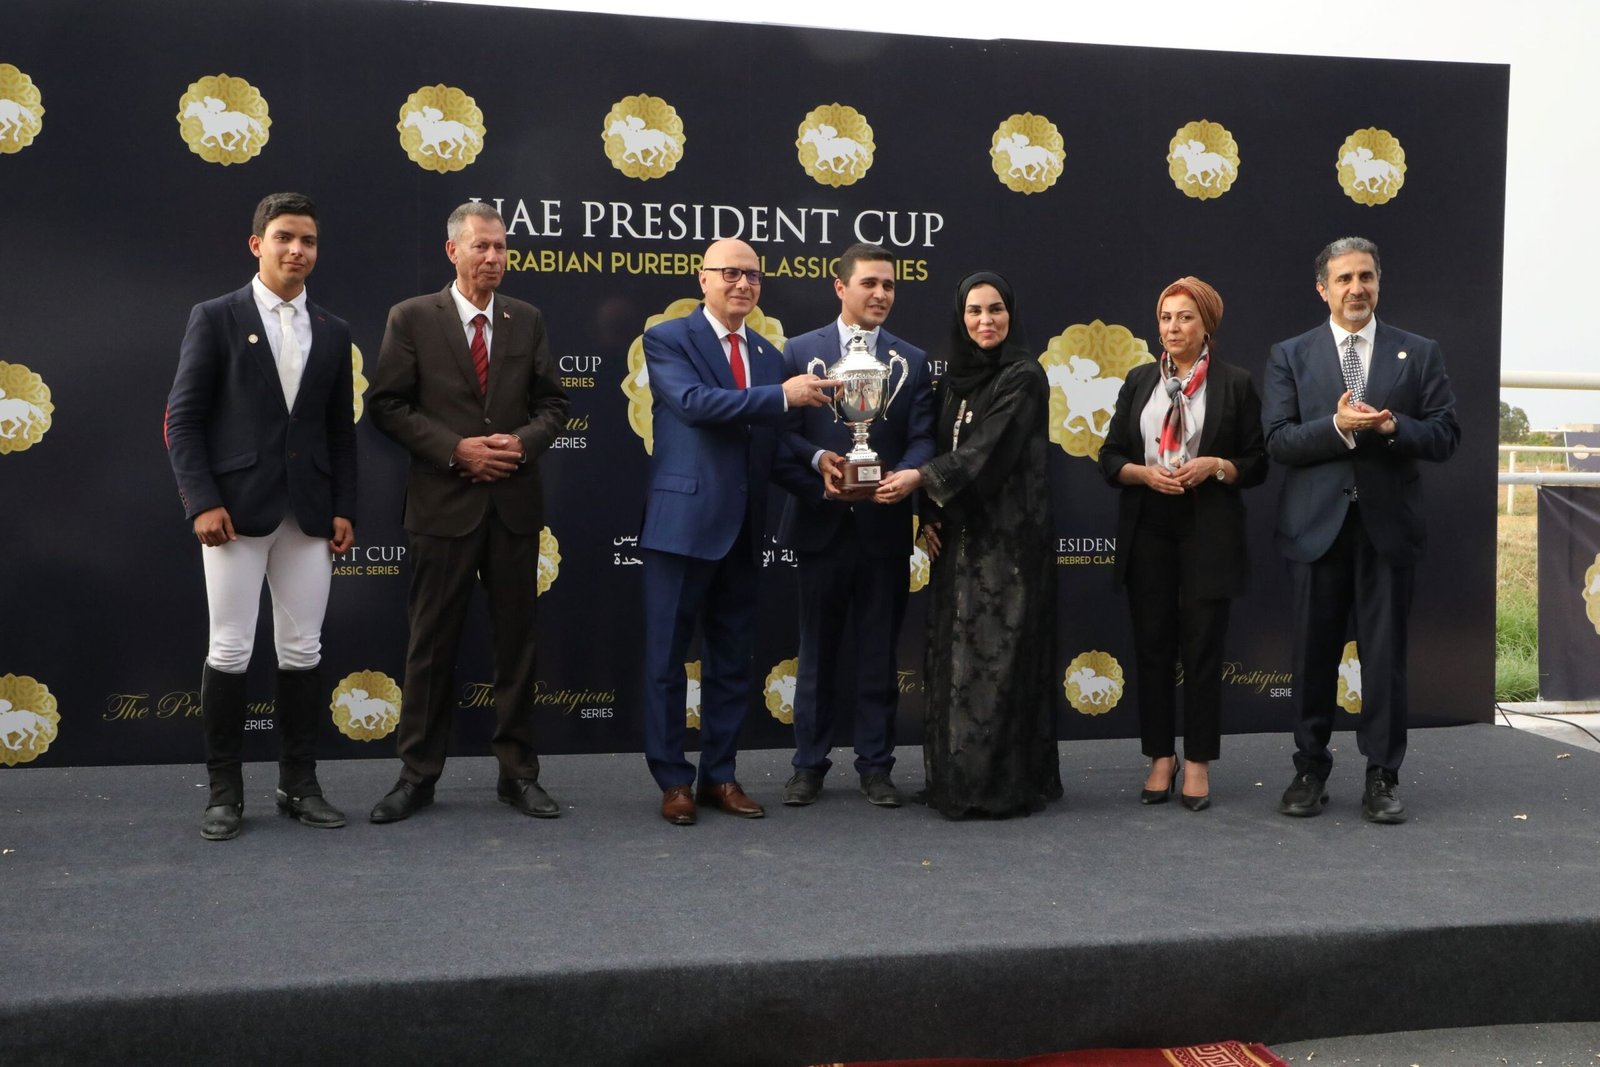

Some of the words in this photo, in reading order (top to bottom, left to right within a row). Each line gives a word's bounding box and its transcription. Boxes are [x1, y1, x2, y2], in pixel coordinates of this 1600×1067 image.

[581, 201, 839, 244] PRESIDENT
[854, 210, 944, 247] CUP
[503, 250, 602, 273] RABIAN
[611, 252, 702, 275] PUREBR
[559, 355, 602, 372] CUP
[1056, 538, 1116, 552] ESIDEN
[366, 546, 406, 561] CUP
[332, 566, 364, 576] ASSIC
[366, 566, 399, 575] SERIES
[1222, 661, 1293, 694] Prestigiou
[533, 681, 615, 715] restigious
[1270, 688, 1292, 697] SERIE
[102, 693, 150, 721] The
[580, 707, 614, 719] SERIES
[244, 719, 274, 731] ERIES
